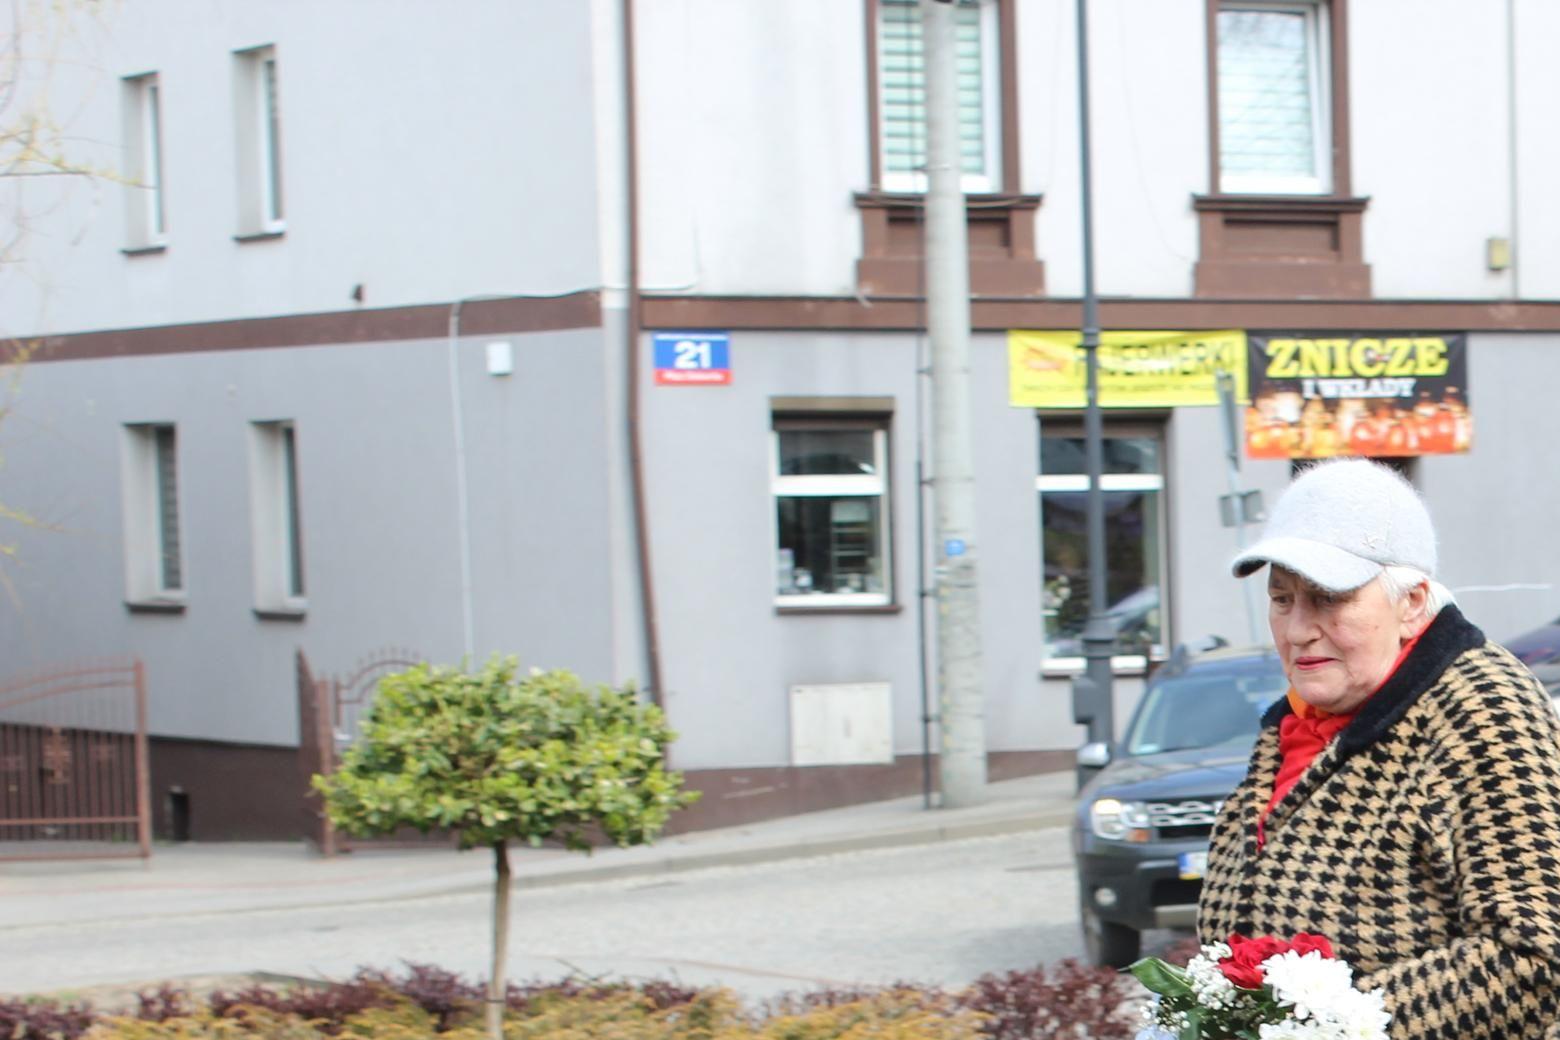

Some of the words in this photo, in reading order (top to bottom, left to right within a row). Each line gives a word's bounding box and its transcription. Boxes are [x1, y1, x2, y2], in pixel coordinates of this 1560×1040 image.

[674, 341, 711, 369] 21
[1266, 339, 1448, 378] ZNICZE
[1302, 378, 1314, 399] I
